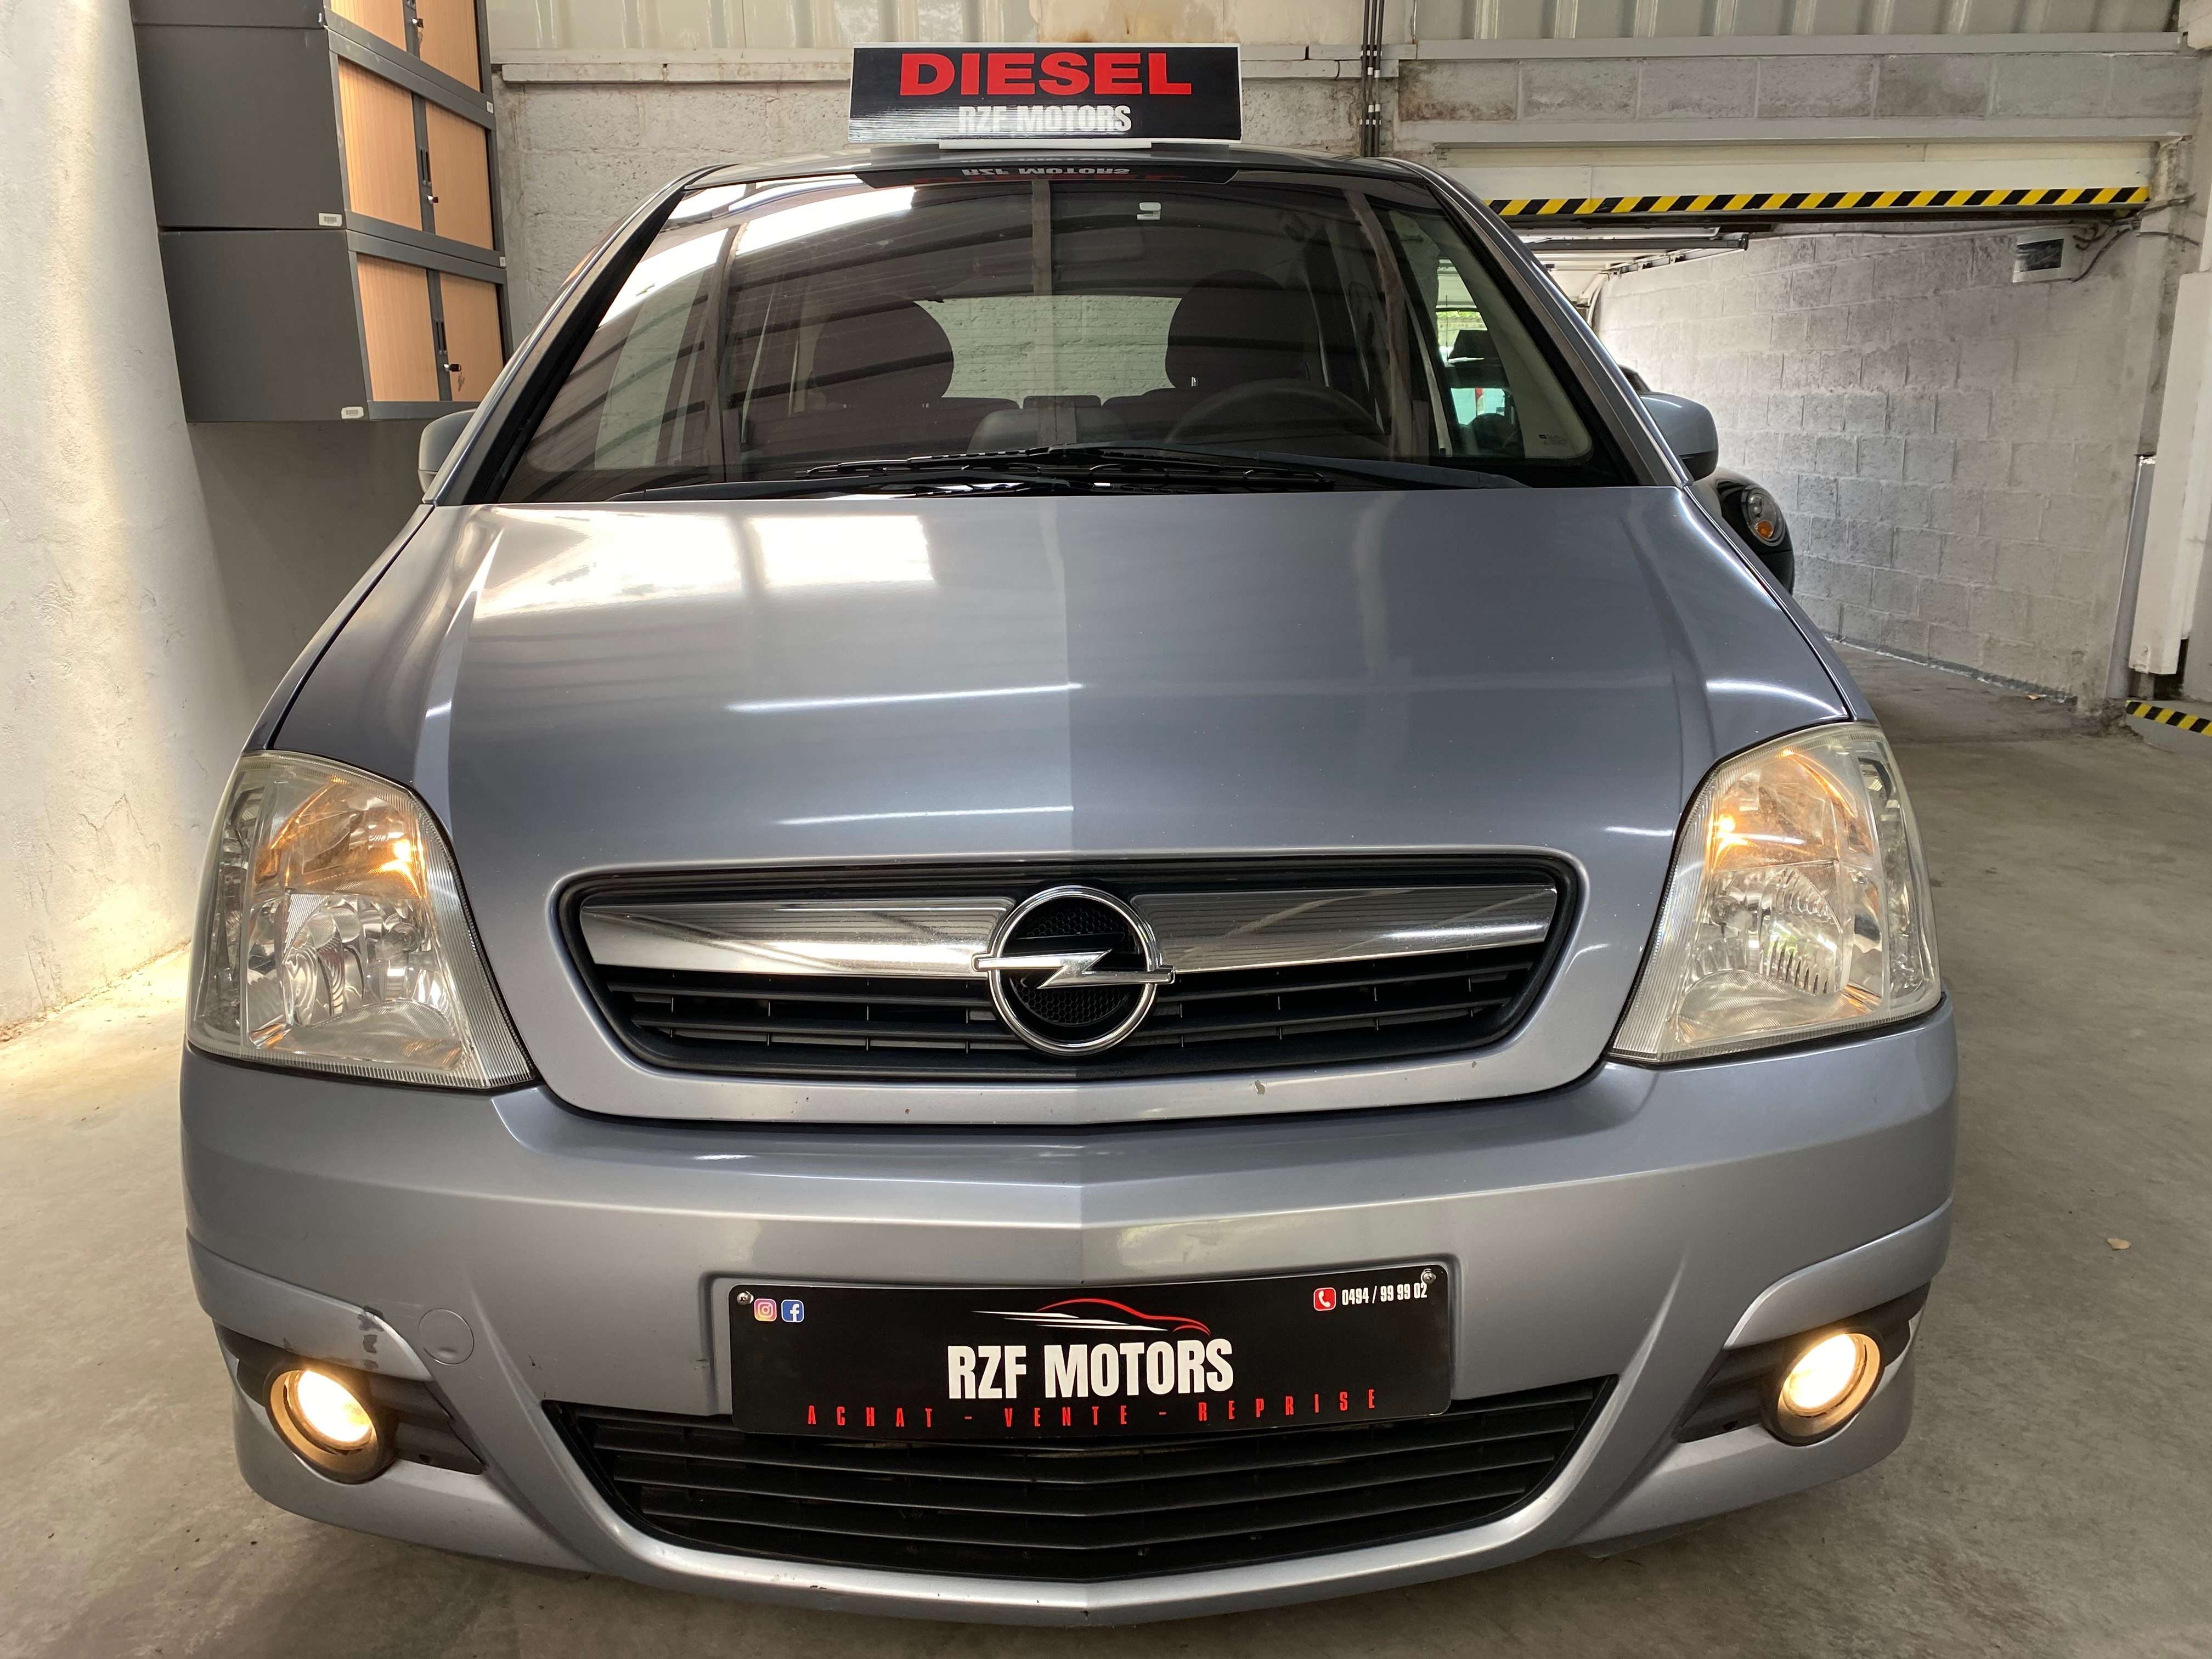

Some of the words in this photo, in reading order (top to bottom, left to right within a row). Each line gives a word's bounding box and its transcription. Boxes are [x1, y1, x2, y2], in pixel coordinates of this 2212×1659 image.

[899, 52, 1192, 96] DIESEL
[958, 105, 1007, 132] RZF
[1017, 105, 1132, 132] MOTORS
[1342, 1287, 1369, 1306] 0494
[1380, 1285, 1394, 1302] 99
[1397, 1283, 1411, 1300] 99
[1413, 1282, 1427, 1299] 02
[947, 1345, 1026, 1399] RZF
[1044, 1338, 1234, 1398] MOTORS
[807, 1404, 933, 1428] ACHAT
[1003, 1404, 1128, 1428] VENTE
[1197, 1388, 1375, 1422] REPRISE
